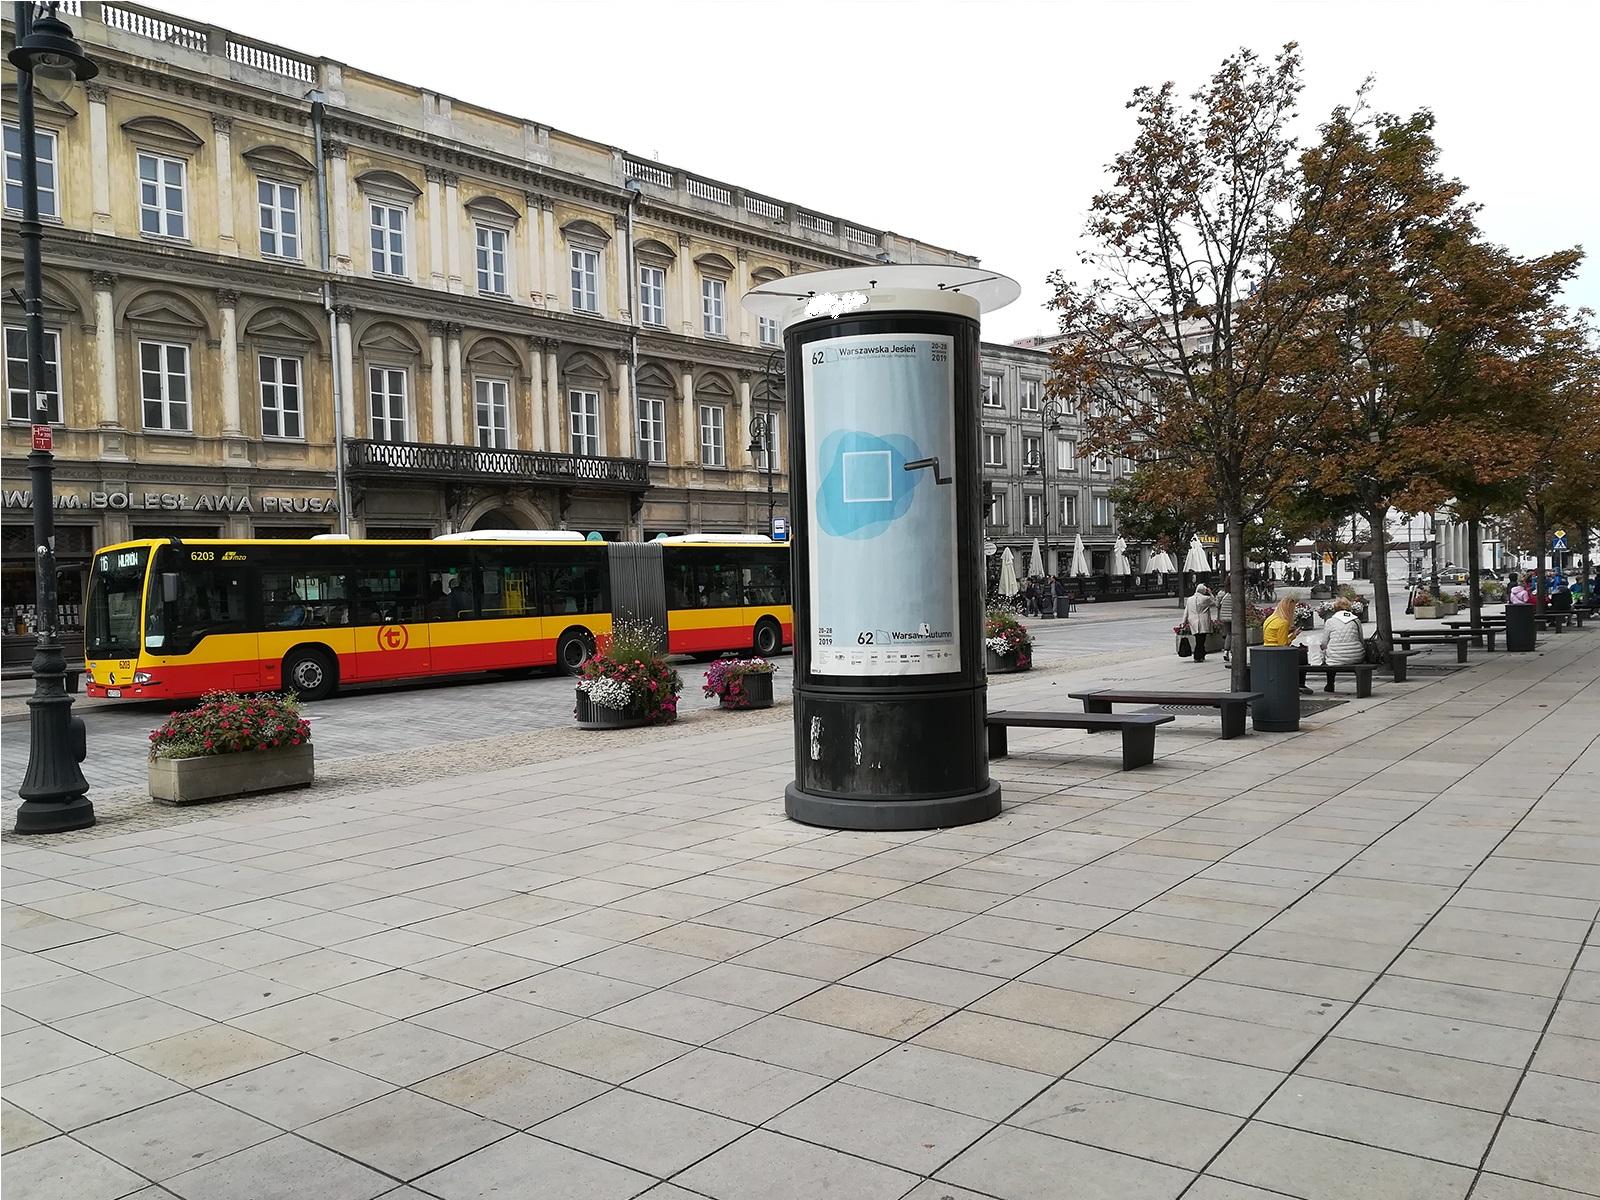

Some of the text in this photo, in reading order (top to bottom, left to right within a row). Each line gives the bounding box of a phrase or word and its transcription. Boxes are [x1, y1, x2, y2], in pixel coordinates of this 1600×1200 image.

[811, 344, 915, 365] 62 Warszawska Jesień
[931, 354, 947, 362] 2019
[91, 491, 254, 512] BOLESŁAWA
[262, 496, 340, 513] PRUSA
[191, 551, 214, 561] 6203
[857, 631, 874, 645] 62
